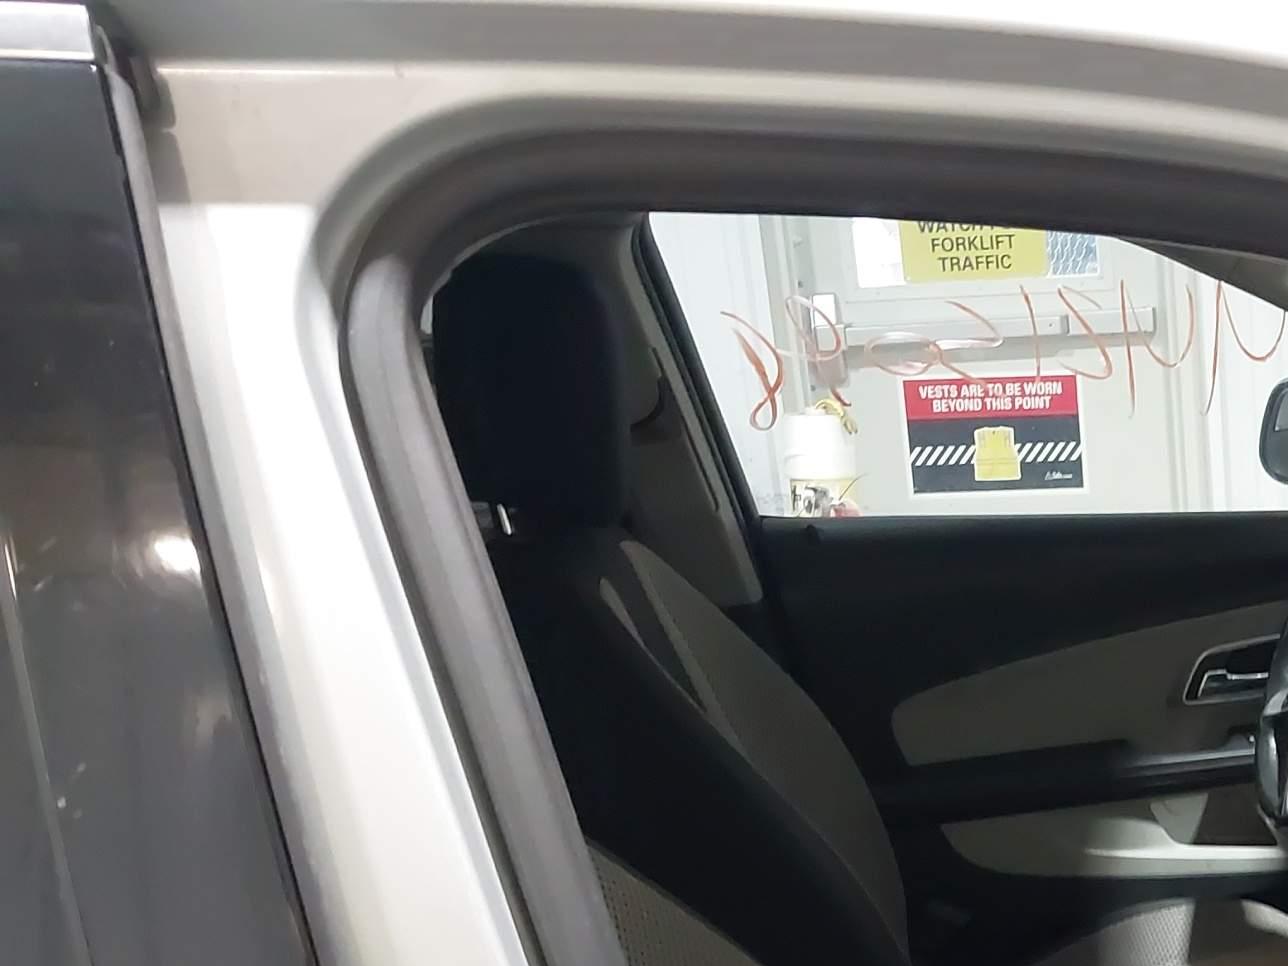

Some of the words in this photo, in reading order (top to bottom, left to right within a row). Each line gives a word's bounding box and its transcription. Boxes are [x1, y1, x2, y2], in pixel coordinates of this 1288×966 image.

[931, 234, 1015, 252] FORKLIFT
[938, 254, 1012, 272] TRAFFIC
[919, 384, 958, 399] VESTS
[960, 383, 985, 397] ARE
[986, 383, 1003, 396] TO
[1005, 382, 1022, 395] BE
[1023, 381, 1063, 395] WORN
[932, 399, 982, 412] BEYOND
[984, 397, 1012, 410] THIS
[1014, 396, 1052, 409] POINT
